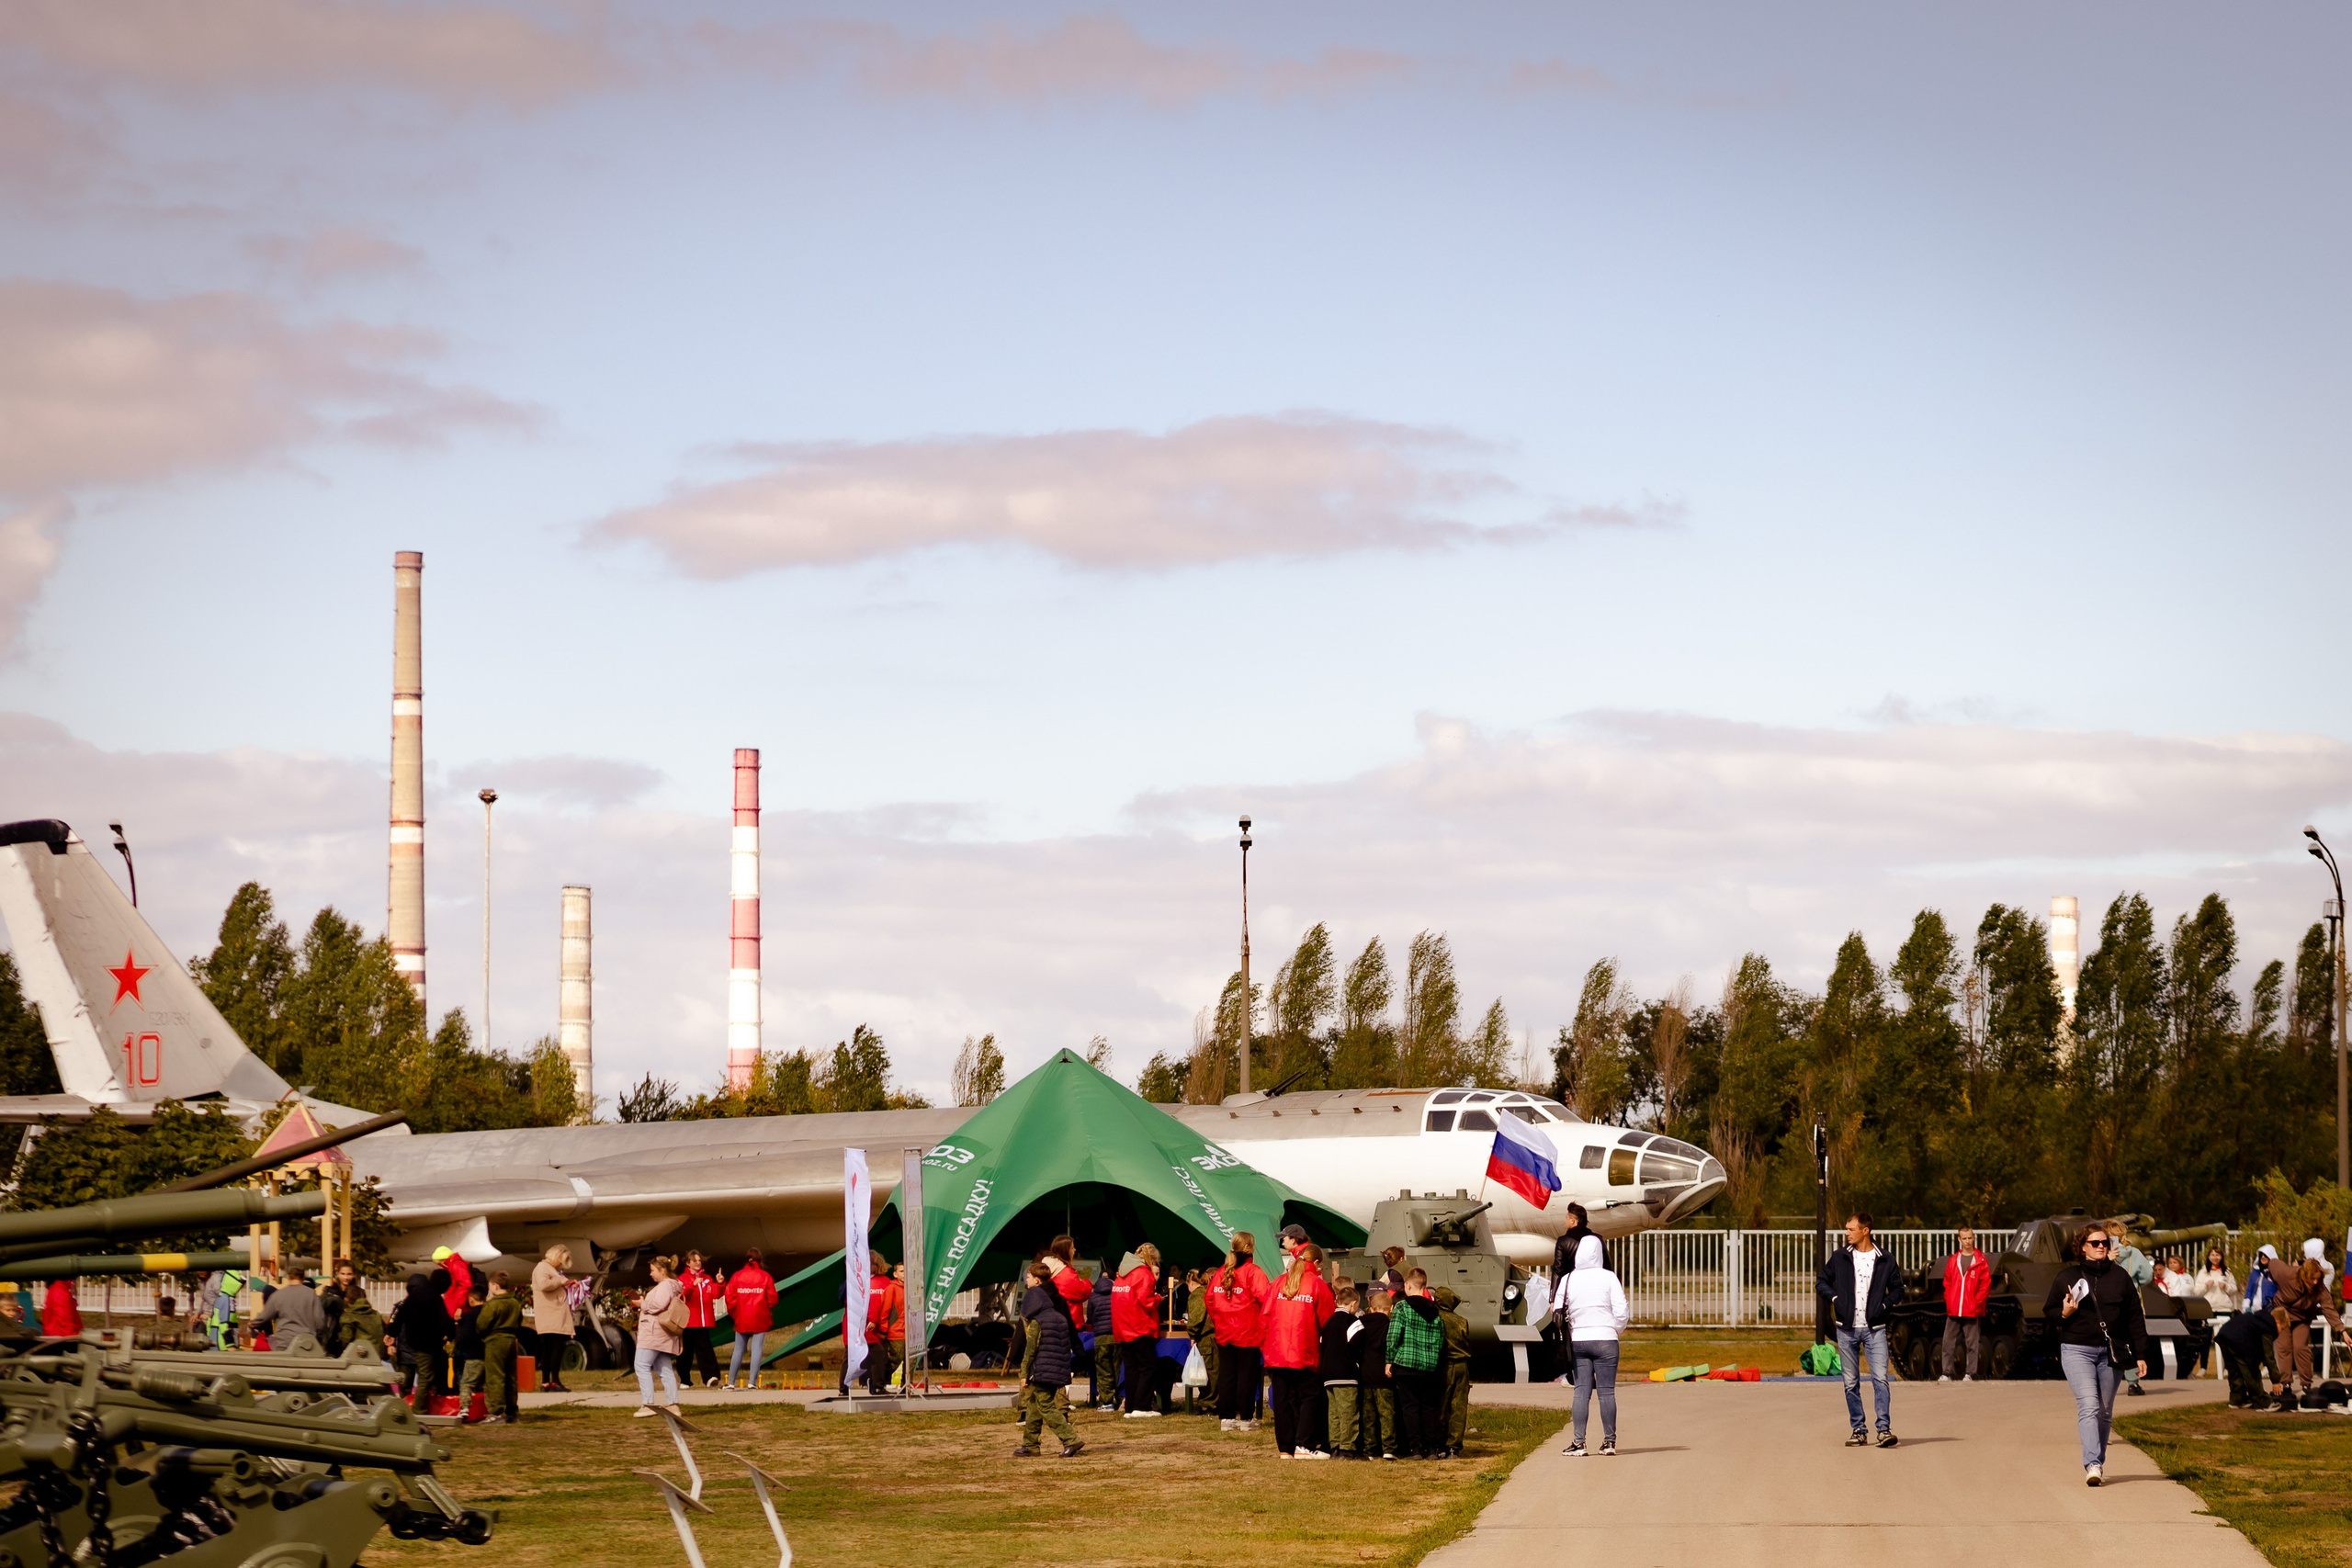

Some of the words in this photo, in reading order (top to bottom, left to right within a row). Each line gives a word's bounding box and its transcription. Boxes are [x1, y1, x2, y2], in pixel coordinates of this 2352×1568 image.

[121, 1031, 163, 1089] 10
[922, 1159, 958, 1171] voz.ru
[923, 1145, 976, 1164] ОЗ
[1191, 1154, 1242, 1171] ЭКО
[947, 1179, 994, 1259] ПОСАДКУ!
[2015, 1230, 2034, 1253] 74
[937, 1263, 959, 1288] НА
[1213, 1286, 1244, 1294] ВОТЁР
